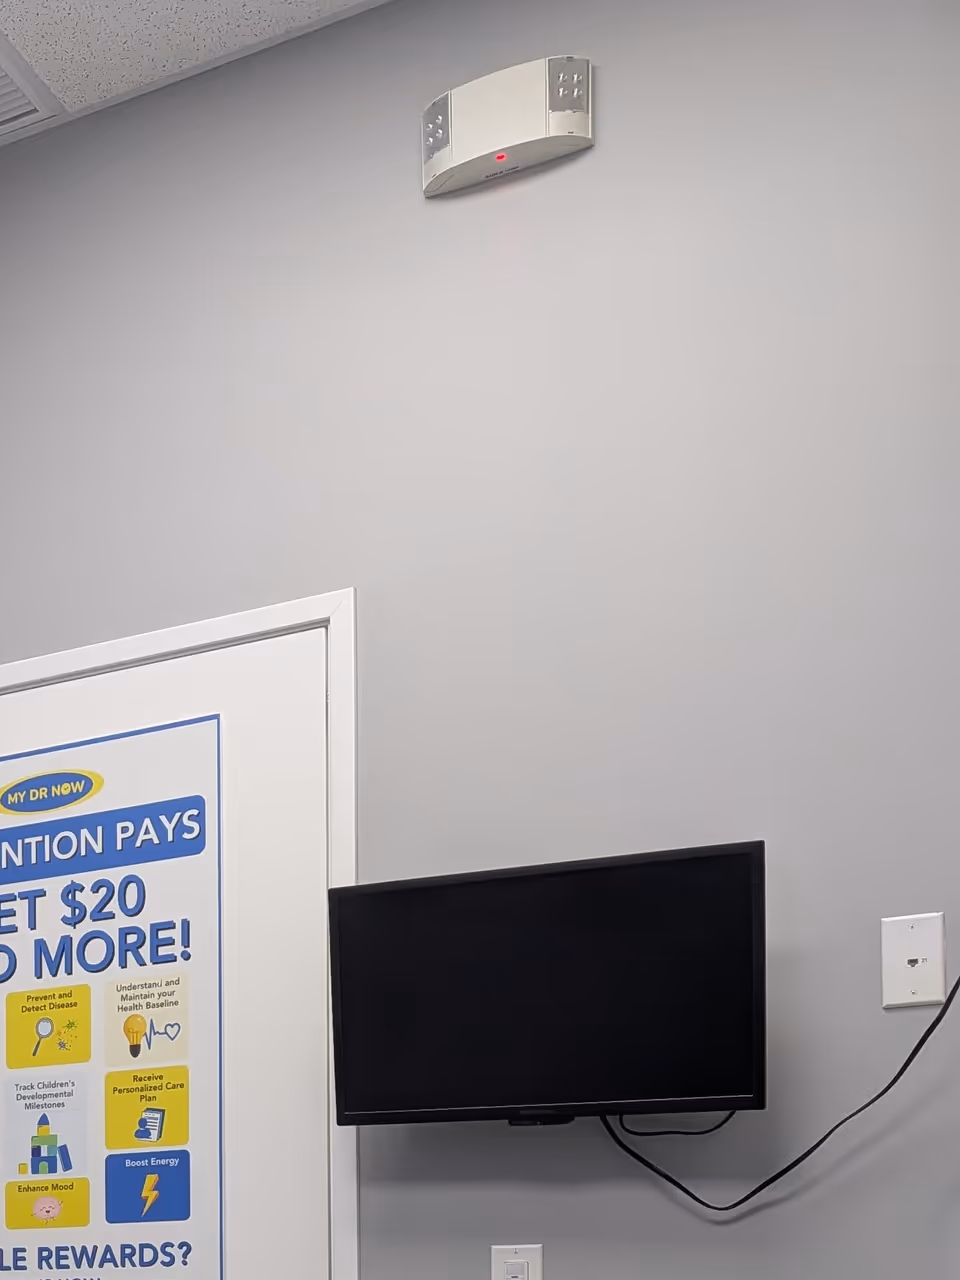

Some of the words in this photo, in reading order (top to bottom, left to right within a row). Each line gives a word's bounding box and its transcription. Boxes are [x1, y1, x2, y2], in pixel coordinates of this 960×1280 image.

[8, 791, 26, 804] MY
[30, 788, 48, 800] DR
[52, 781, 84, 797] NOW
[117, 809, 200, 851] PAYS
[61, 875, 146, 928] $20
[34, 919, 191, 979] MORE!
[116, 980, 162, 992] Understand
[165, 978, 180, 986] and
[26, 992, 56, 1003] Prevent
[58, 990, 73, 1000] and
[121, 992, 155, 1002] Maintain
[157, 989, 175, 999] your
[21, 1002, 48, 1013] Detect
[50, 1000, 78, 1011] Disease
[118, 1001, 143, 1012] Health
[146, 1000, 179, 1009] Baseline
[133, 1074, 163, 1083] Receive
[15, 1083, 35, 1092] Track
[37, 1080, 76, 1091] Children's
[113, 1084, 163, 1094] Personalized
[16, 1090, 74, 1101] Developmental
[140, 1094, 156, 1102] Plan
[24, 1101, 65, 1110] Milestones
[126, 1159, 148, 1167] Boost
[151, 1158, 179, 1167] Energy
[17, 1185, 49, 1193] Enhance
[51, 1182, 74, 1191] Mood
[37, 1241, 192, 1270] REWARDS?
